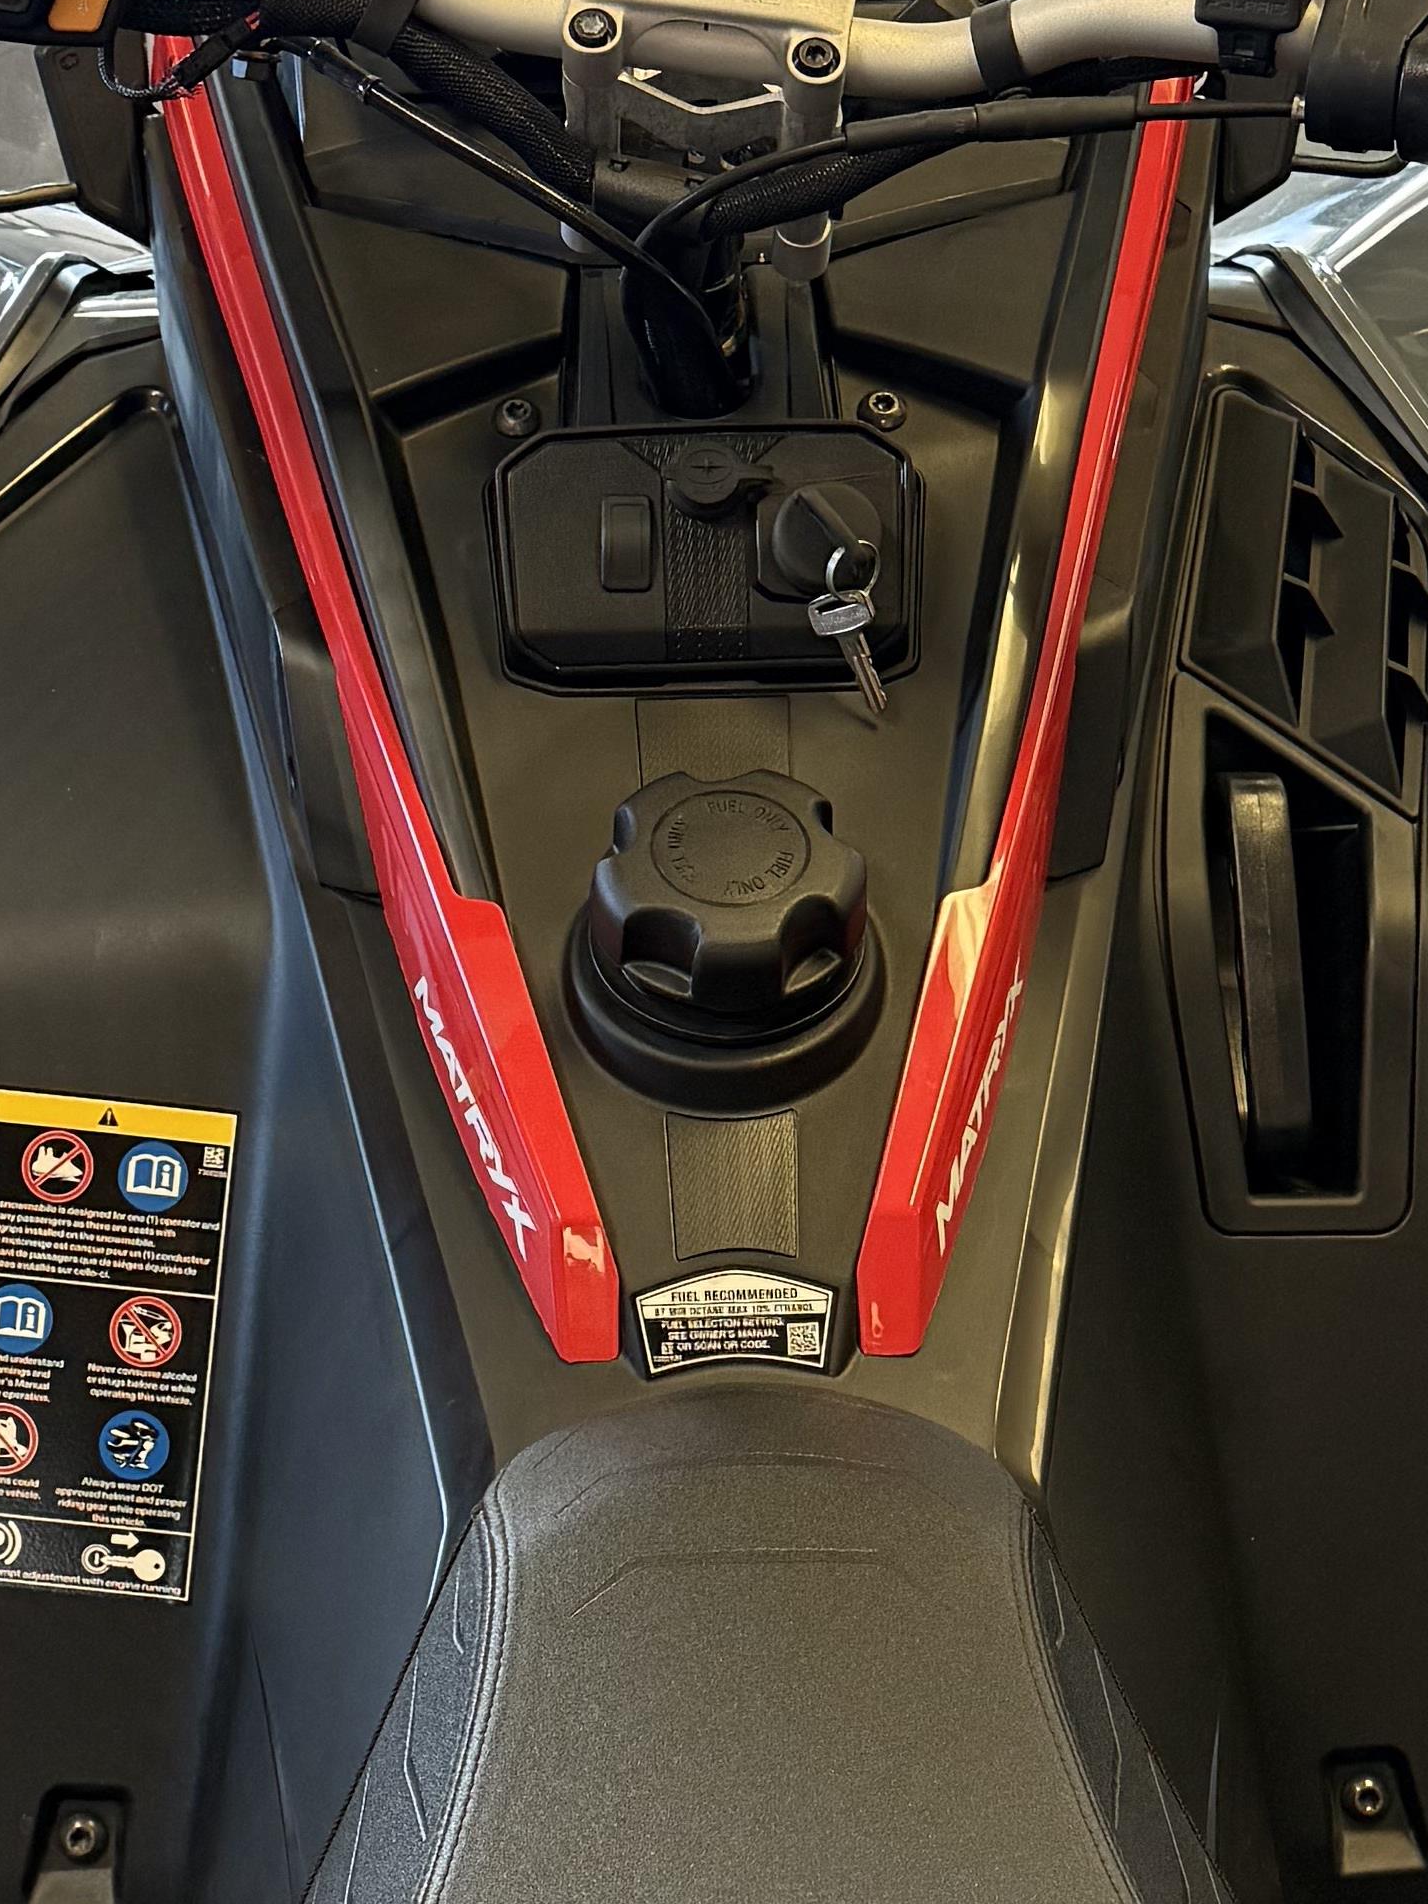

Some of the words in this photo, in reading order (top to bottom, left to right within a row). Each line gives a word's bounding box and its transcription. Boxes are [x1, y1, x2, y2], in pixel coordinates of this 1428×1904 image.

[708, 799, 747, 814] FUEL
[754, 805, 790, 832] ONLY
[764, 849, 795, 879] FUEL
[723, 875, 765, 896] ONLY
[936, 944, 1024, 1258] MATRYX
[414, 975, 538, 1262] MATRYX
[17, 1214, 72, 1227] passengers
[112, 1225, 127, 1233] are
[58, 1205, 66, 1214] is
[67, 1206, 112, 1219] designed
[127, 1215, 145, 1223] one
[146, 1214, 159, 1226] (1)
[160, 1217, 201, 1229] operator
[201, 1222, 221, 1232] and
[24, 1225, 66, 1238] installed
[66, 1231, 78, 1239] on
[79, 1231, 95, 1241] the
[16, 1249, 28, 1258] de
[29, 1251, 78, 1264] passagers
[79, 1257, 98, 1266] que
[99, 1258, 112, 1267] de
[184, 1267, 197, 1276] de
[53, 1242, 68, 1250] est
[106, 1247, 129, 1257] pour
[129, 1249, 142, 1258] un
[143, 1249, 155, 1261] (1)
[156, 1252, 212, 1265] conducteur
[57, 1266, 72, 1274] sur
[73, 1267, 111, 1279] celle-ci.
[672, 1291, 700, 1302] FUEL
[704, 1288, 798, 1302] RECOMMENDED
[690, 1305, 723, 1315] OCTANE
[727, 1305, 748, 1314] MAX
[752, 1304, 770, 1313] 10%
[774, 1303, 814, 1313] ETHANOL
[661, 1320, 686, 1329] FUEL
[688, 1318, 740, 1329] SELECTION
[668, 1331, 687, 1341] SEE
[689, 1330, 735, 1340] OWNER'S
[737, 1328, 780, 1338] MANUAL
[677, 1341, 692, 1351] OR
[694, 1341, 721, 1350] SCAN
[723, 1340, 738, 1350] QR
[740, 1339, 771, 1349] CODE.
[10, 1355, 65, 1368] understand
[32, 1369, 51, 1379] and
[87, 1362, 116, 1374] Never
[116, 1367, 162, 1379] consume
[162, 1372, 198, 1382] alcohol
[14, 1378, 51, 1390] Manual
[86, 1376, 97, 1384] or
[97, 1376, 126, 1388] drugs
[126, 1379, 158, 1390] before
[159, 1383, 169, 1391] or
[171, 1384, 196, 1394] while
[89, 1388, 137, 1402] operating
[137, 1392, 155, 1402] this
[156, 1395, 193, 1406] vehicle.
[12, 1478, 40, 1488] could
[81, 1476, 116, 1490] Always
[117, 1482, 141, 1491] wear
[141, 1483, 165, 1494] DOT
[5, 1489, 41, 1500] vehicle.
[54, 1487, 101, 1500] approved
[102, 1491, 135, 1503] helmet
[135, 1496, 155, 1504] and
[155, 1497, 188, 1508] proper
[57, 1499, 85, 1511] riding
[86, 1502, 108, 1512] gear
[108, 1504, 134, 1514] while
[134, 1507, 181, 1521] operating
[92, 1513, 110, 1522] this
[110, 1516, 147, 1528] vehicle.
[22, 1570, 80, 1585] adjustment
[81, 1577, 104, 1587] with
[104, 1580, 141, 1591] engine
[141, 1583, 181, 1596] running
